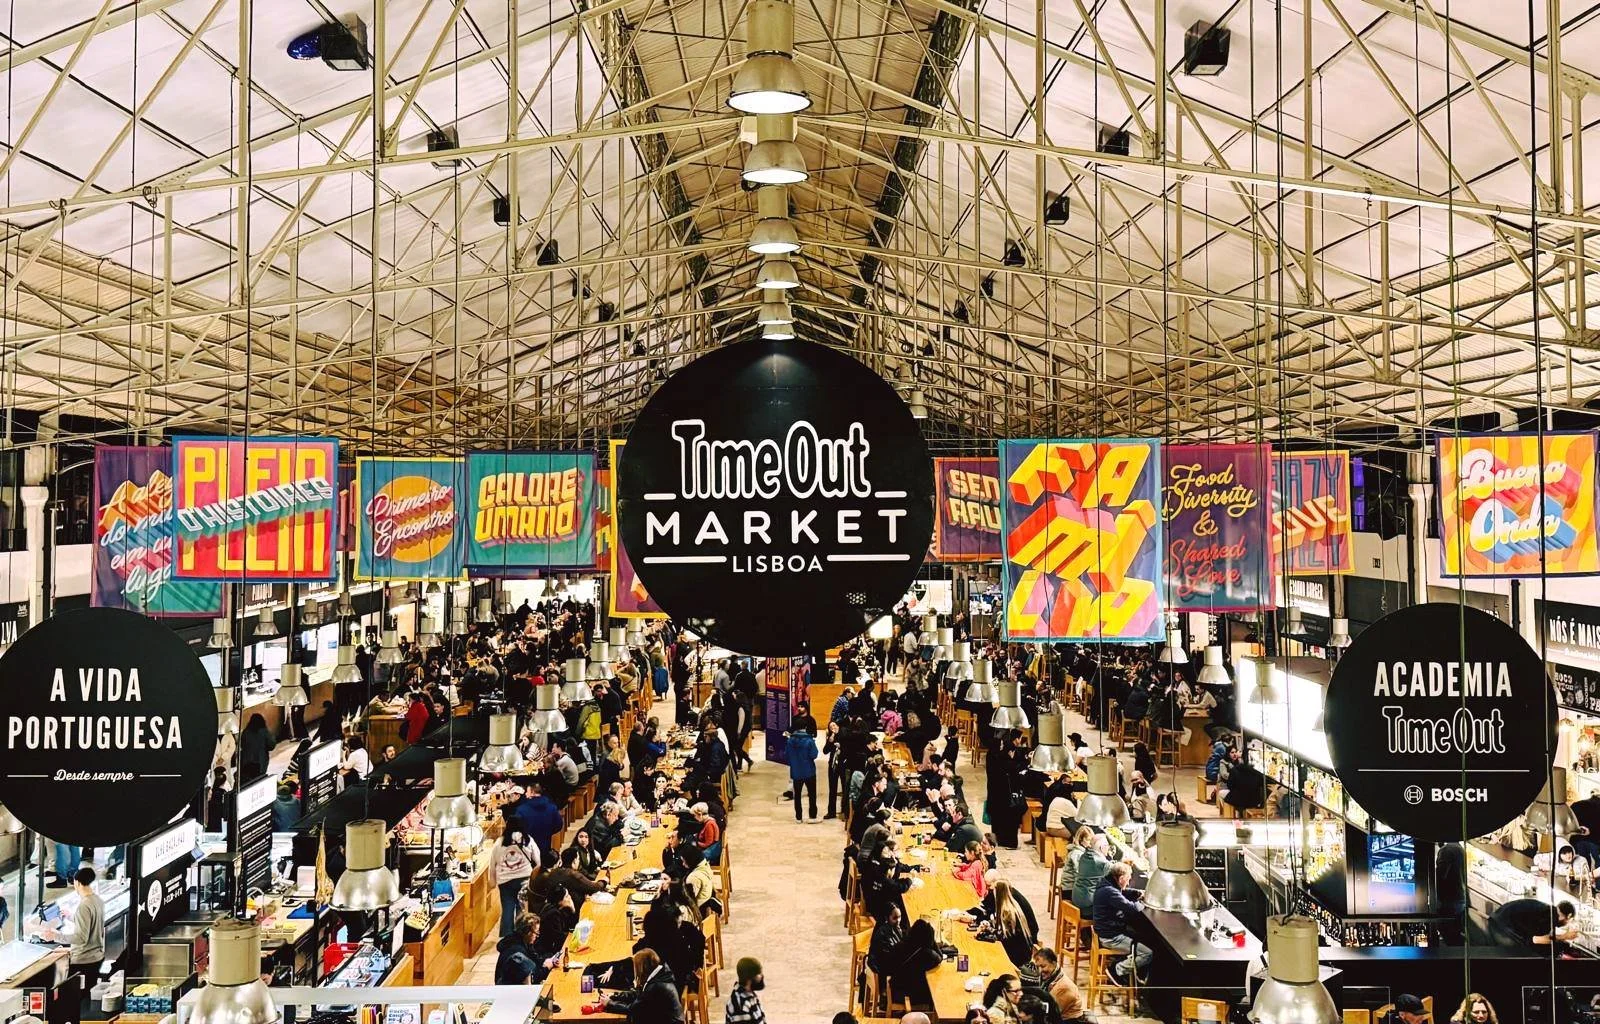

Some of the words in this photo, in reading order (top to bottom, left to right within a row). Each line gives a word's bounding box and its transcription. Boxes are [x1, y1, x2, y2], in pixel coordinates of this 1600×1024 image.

[671, 419, 782, 499] Time
[784, 420, 871, 498] Out
[478, 467, 577, 509] CALORE
[1170, 463, 1234, 500] Food
[366, 485, 452, 517] Primeiro
[1161, 484, 1258, 521] Diversity
[374, 510, 457, 557] Encontro
[475, 500, 576, 543] UMANO
[646, 509, 907, 545] MARKET
[1192, 510, 1219, 536] &
[732, 555, 823, 573] LISBOA
[1163, 535, 1247, 577] Shared
[1176, 561, 1241, 597] Love
[1549, 615, 1568, 644] NÓS
[1570, 617, 1576, 644] É
[50, 668, 66, 702] A
[79, 668, 142, 702] VIDA
[1374, 661, 1513, 698] ACADEMIA
[8, 716, 183, 750] PORTUGUESA
[1382, 705, 1451, 754] Time
[1453, 706, 1506, 754] Out
[54, 769, 91, 781] Desde
[91, 772, 134, 783] sempre
[1431, 788, 1488, 802] BOSCH
